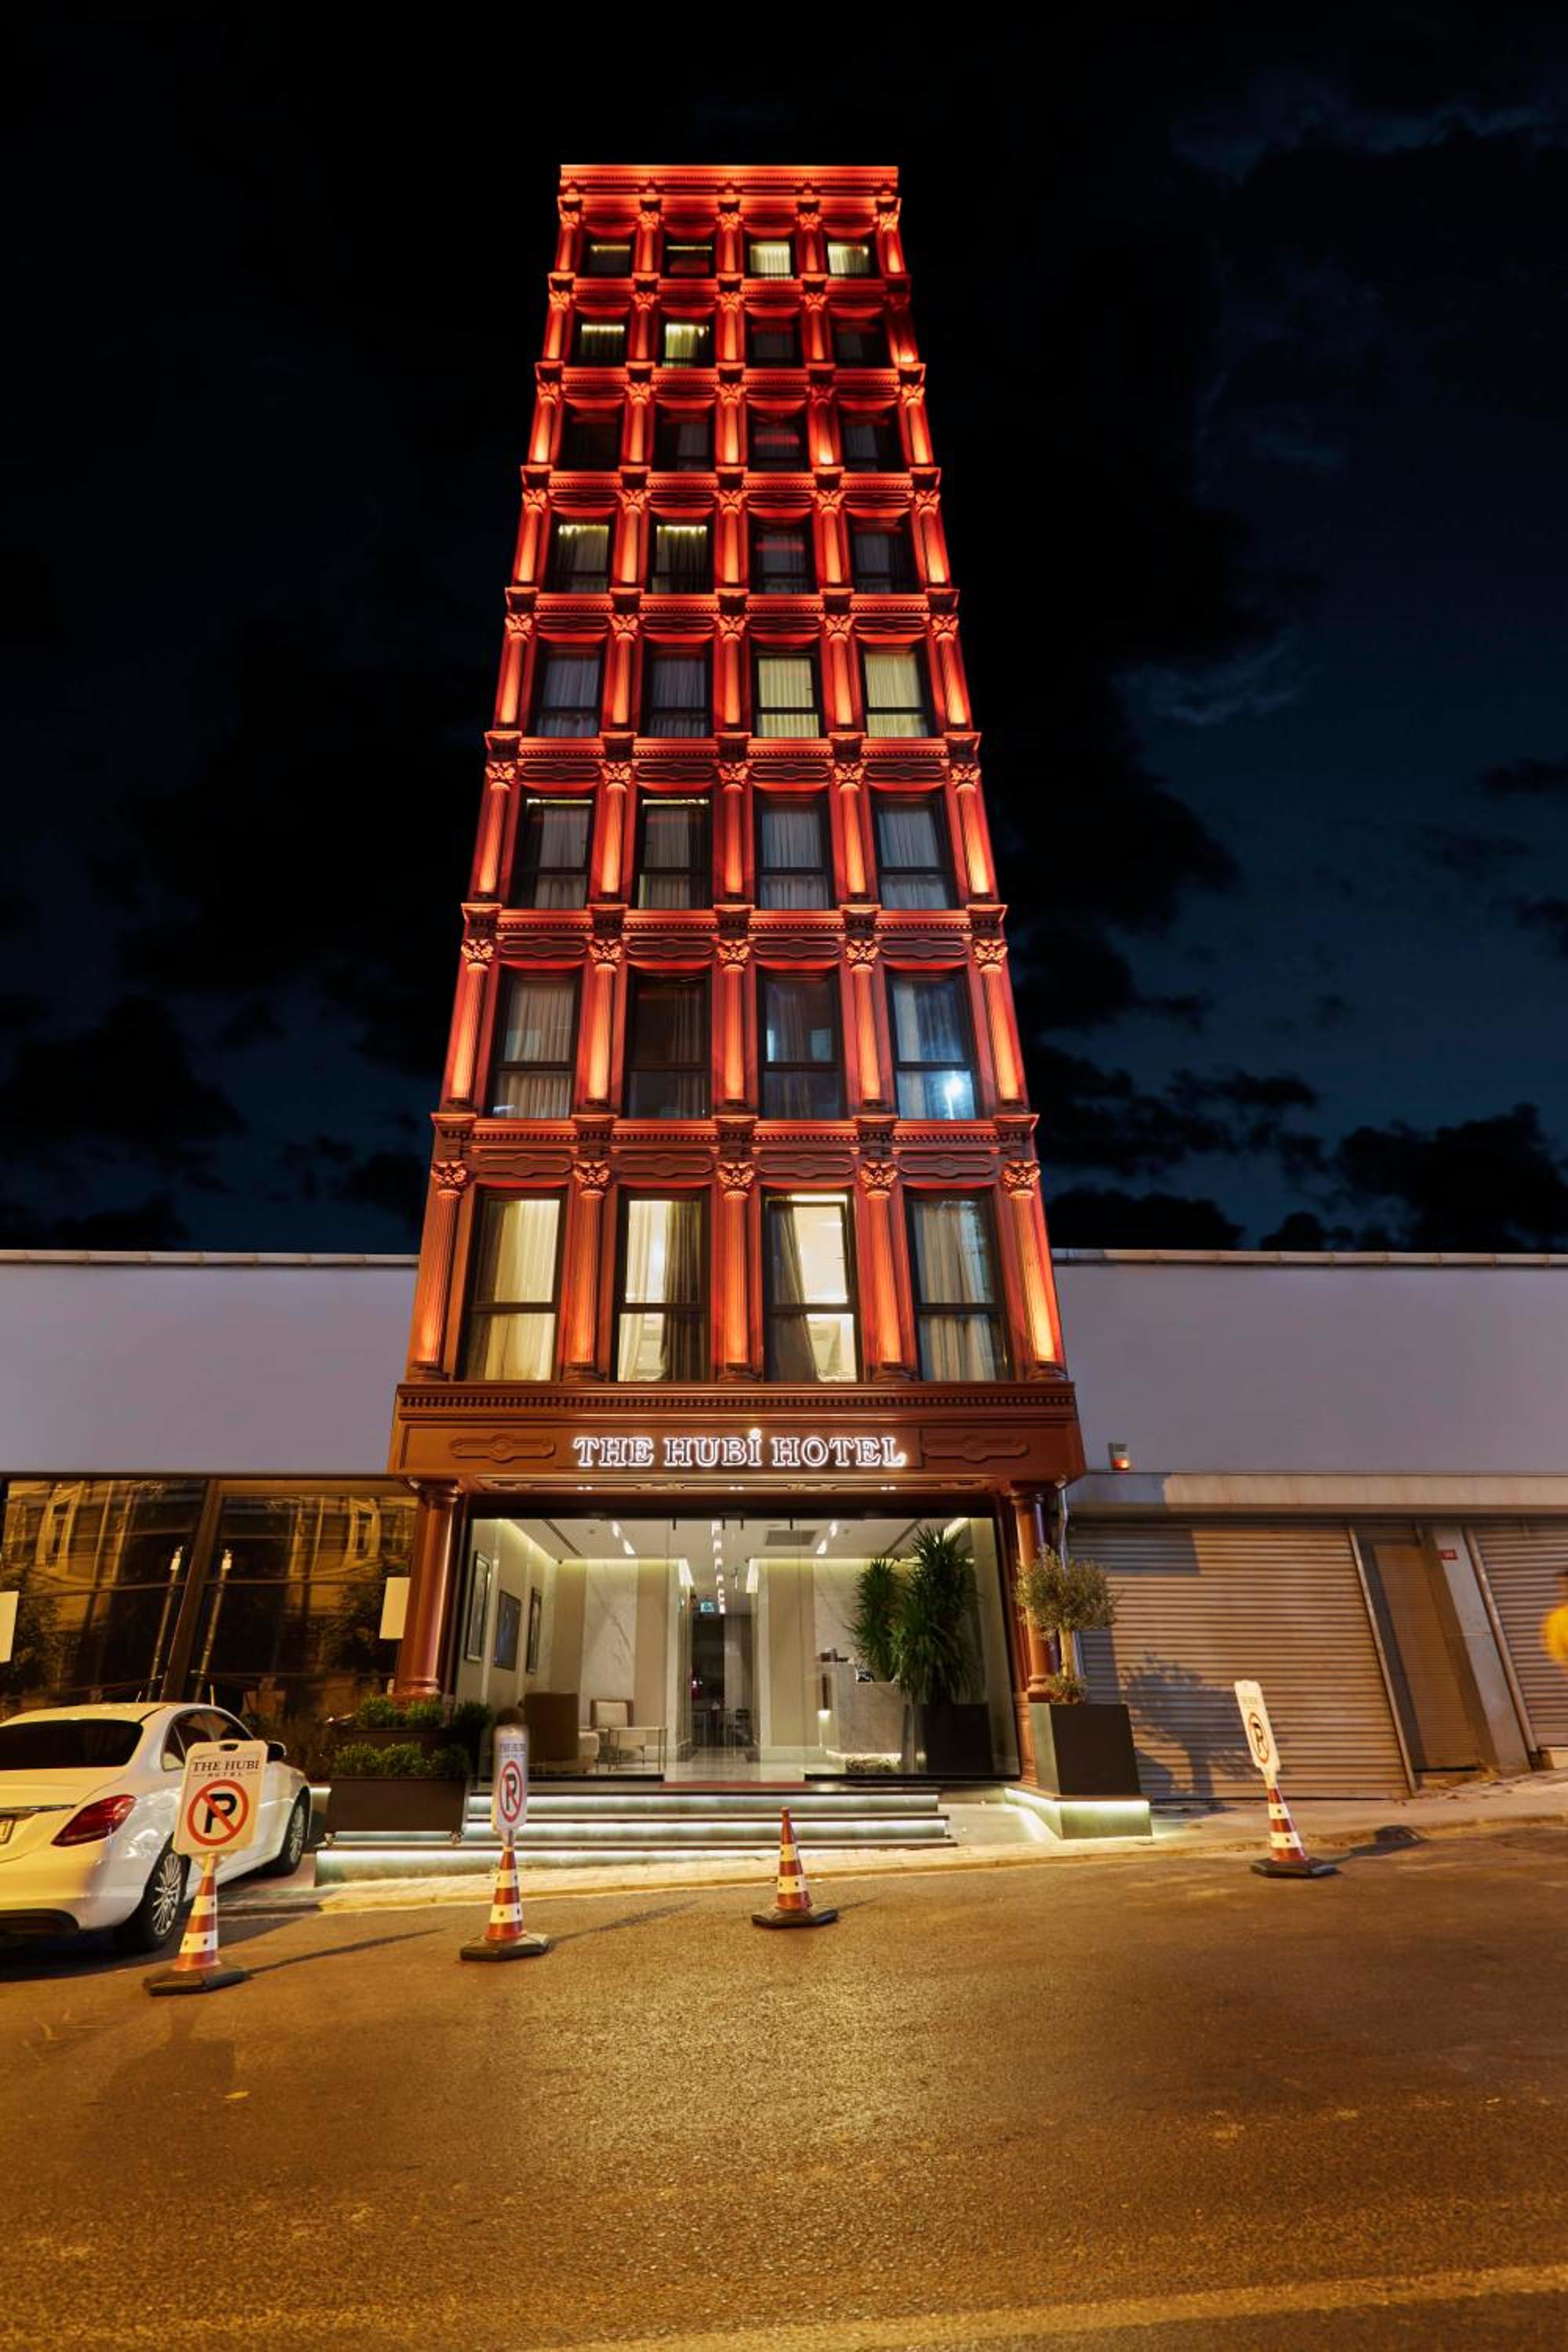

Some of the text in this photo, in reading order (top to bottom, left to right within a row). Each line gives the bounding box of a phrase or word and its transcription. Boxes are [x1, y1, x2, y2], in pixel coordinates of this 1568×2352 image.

[573, 1437, 654, 1467] THE
[771, 1437, 907, 1467] HOTEL
[193, 1761, 221, 1772] THE
[204, 1793, 238, 1834] P
